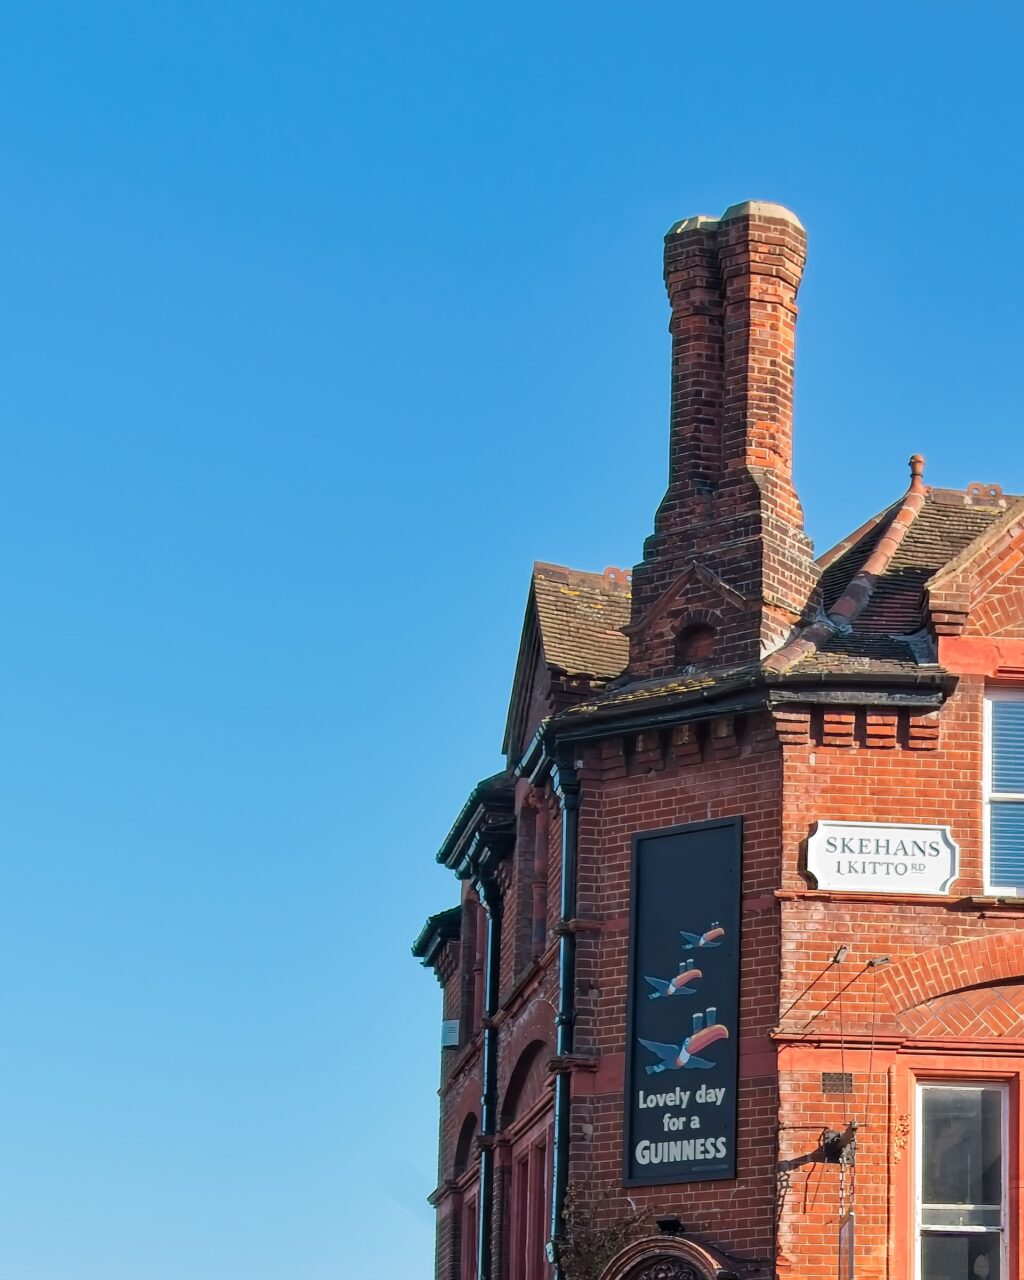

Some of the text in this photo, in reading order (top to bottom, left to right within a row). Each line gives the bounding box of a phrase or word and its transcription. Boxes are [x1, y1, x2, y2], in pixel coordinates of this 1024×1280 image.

[825, 837, 940, 857] SKEHANS
[849, 861, 908, 875] KITTO
[911, 863, 926, 873] RD
[639, 1084, 726, 1109] Lovely day
[662, 1113, 700, 1131] for a
[635, 1137, 727, 1164] GUINNESS
